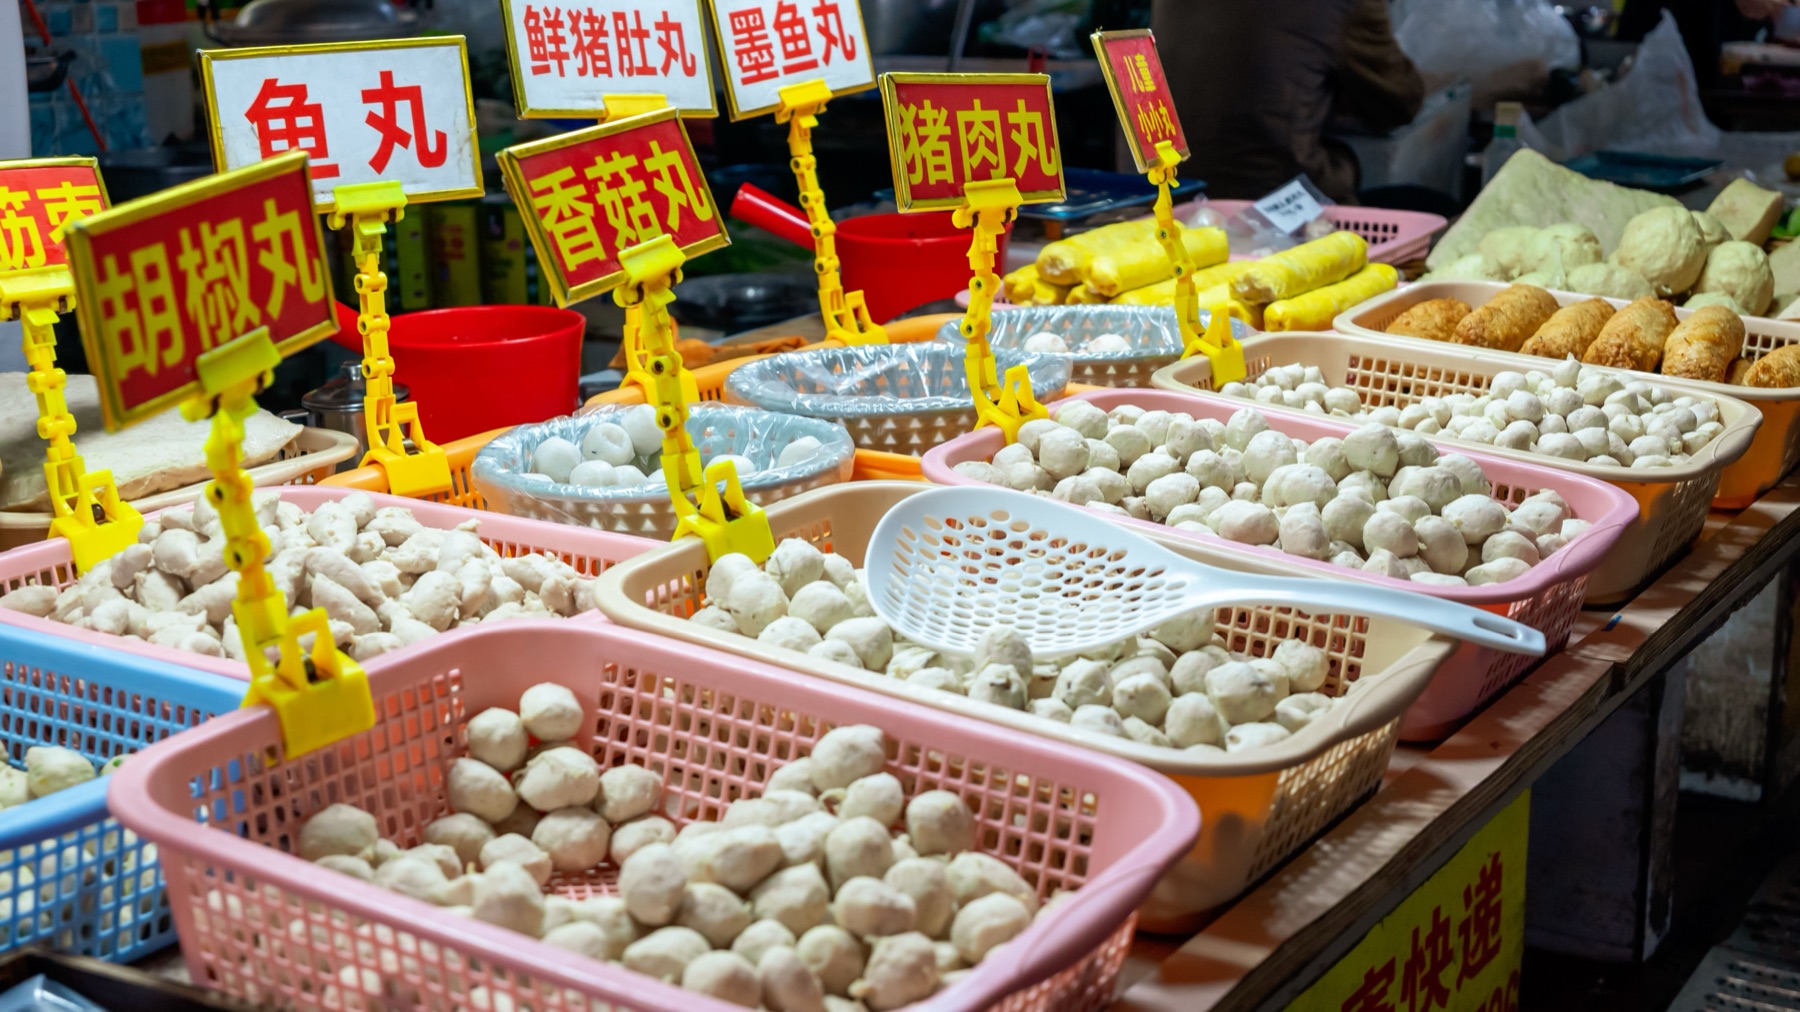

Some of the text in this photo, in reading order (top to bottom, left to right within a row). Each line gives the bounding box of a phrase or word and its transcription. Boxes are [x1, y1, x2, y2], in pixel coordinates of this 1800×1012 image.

[523, 5, 697, 78] 鲜猪肚丸
[728, 0, 857, 86] 墨鱼丸
[1123, 53, 1157, 94] 儿童
[244, 70, 448, 180] 鱼丸
[897, 98, 1058, 185] 猪肉丸
[1137, 99, 1177, 143] 小小丸
[529, 140, 714, 272] 香菇丸
[99, 198, 326, 380] 胡椒丸
